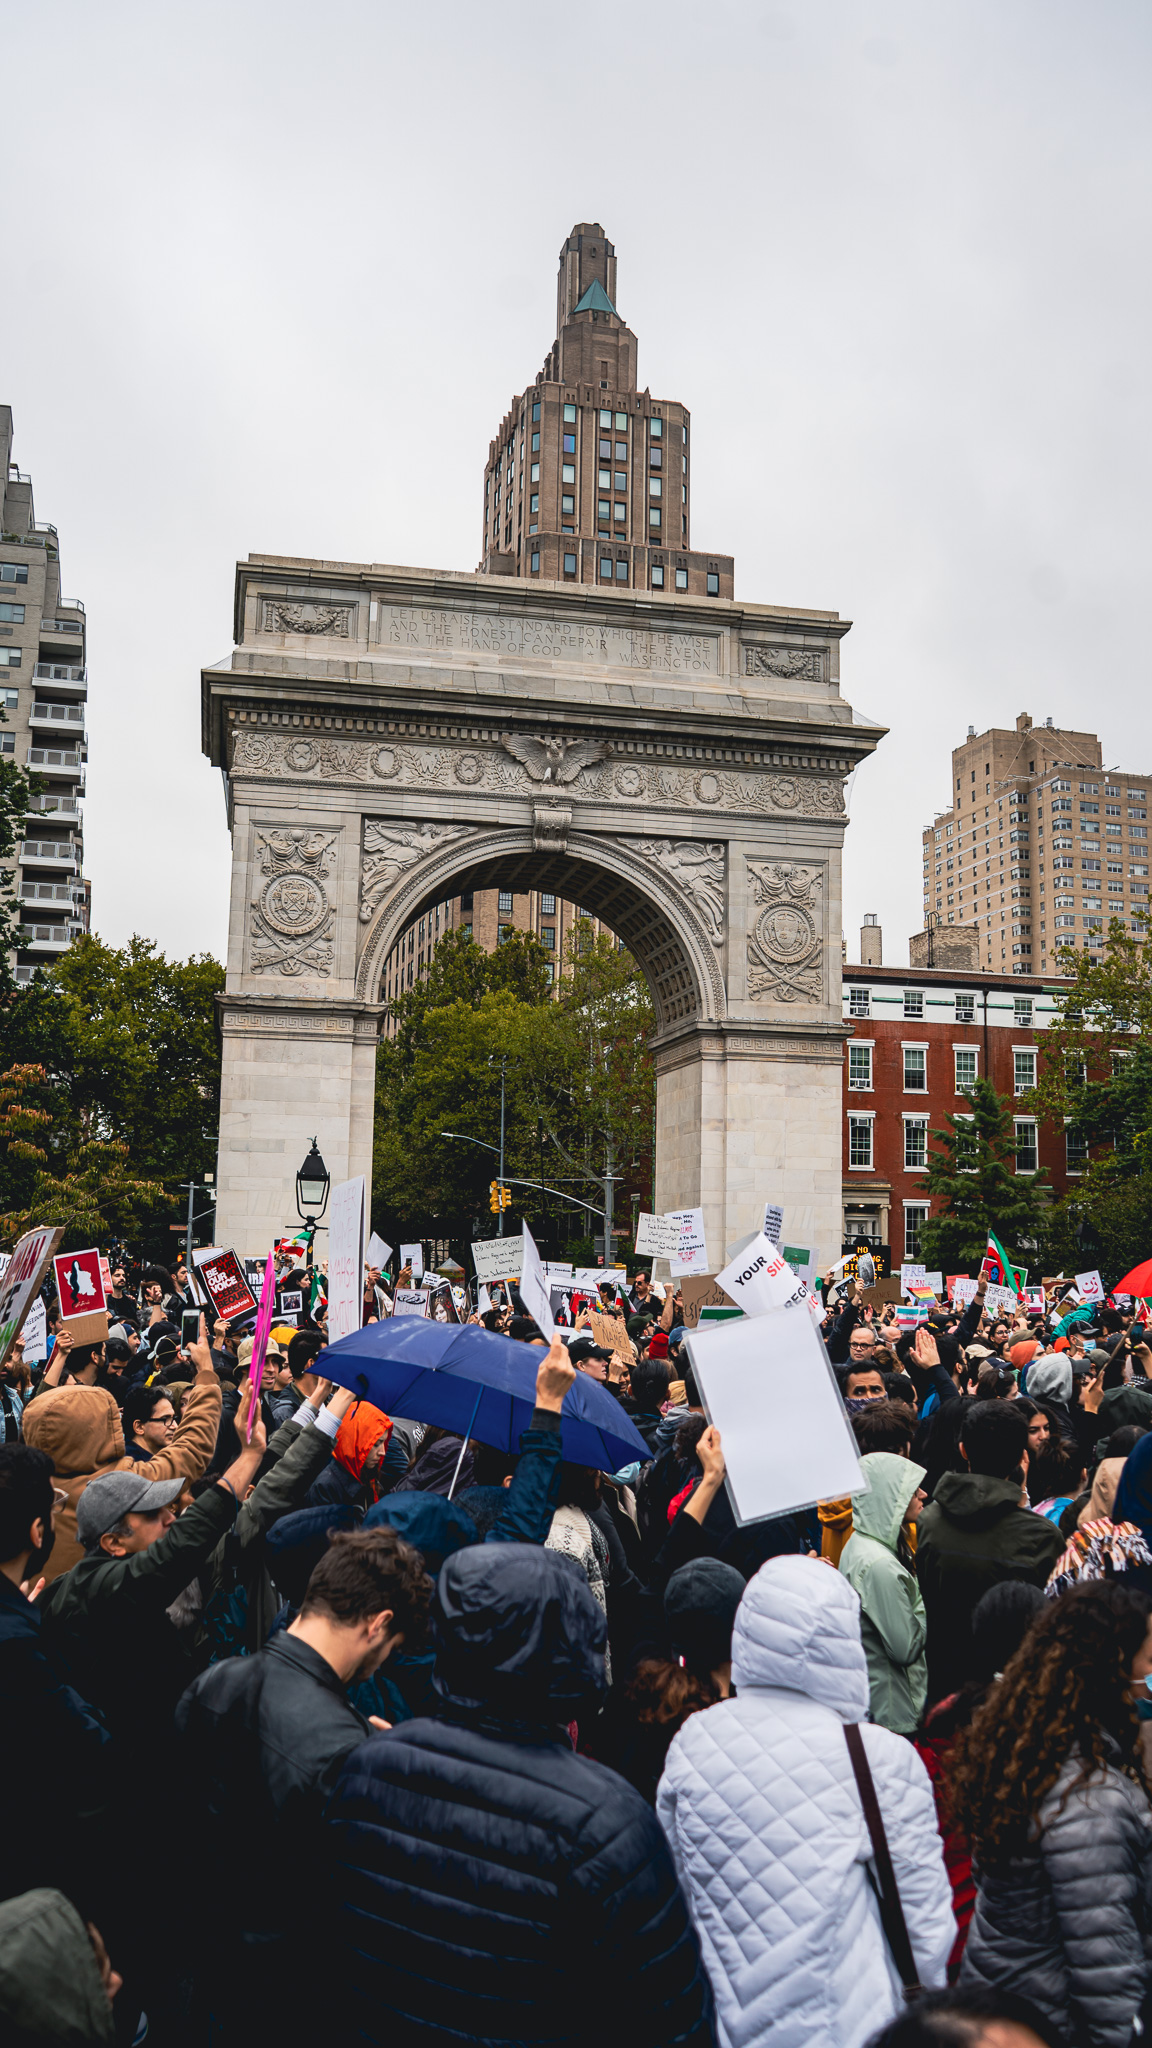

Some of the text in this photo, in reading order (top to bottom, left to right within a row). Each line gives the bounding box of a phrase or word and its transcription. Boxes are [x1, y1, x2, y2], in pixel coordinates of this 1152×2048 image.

[390, 608, 710, 648] LET US RAISE A STANDARD TO WHICH THE WISE
[390, 621, 710, 659] AND THE HONEST CAN REPAIR THE EVENT
[389, 632, 711, 670] IS IN THE HAND OF GOD WASHINGTON
[205, 1267, 218, 1279] BE
[208, 1272, 227, 1286] OUR
[734, 1256, 767, 1286] YOUR
[904, 1266, 925, 1276] FREE
[211, 1276, 237, 1294] VOICE
[903, 1279, 925, 1288] IRAN
[1082, 1277, 1099, 1294] زن
